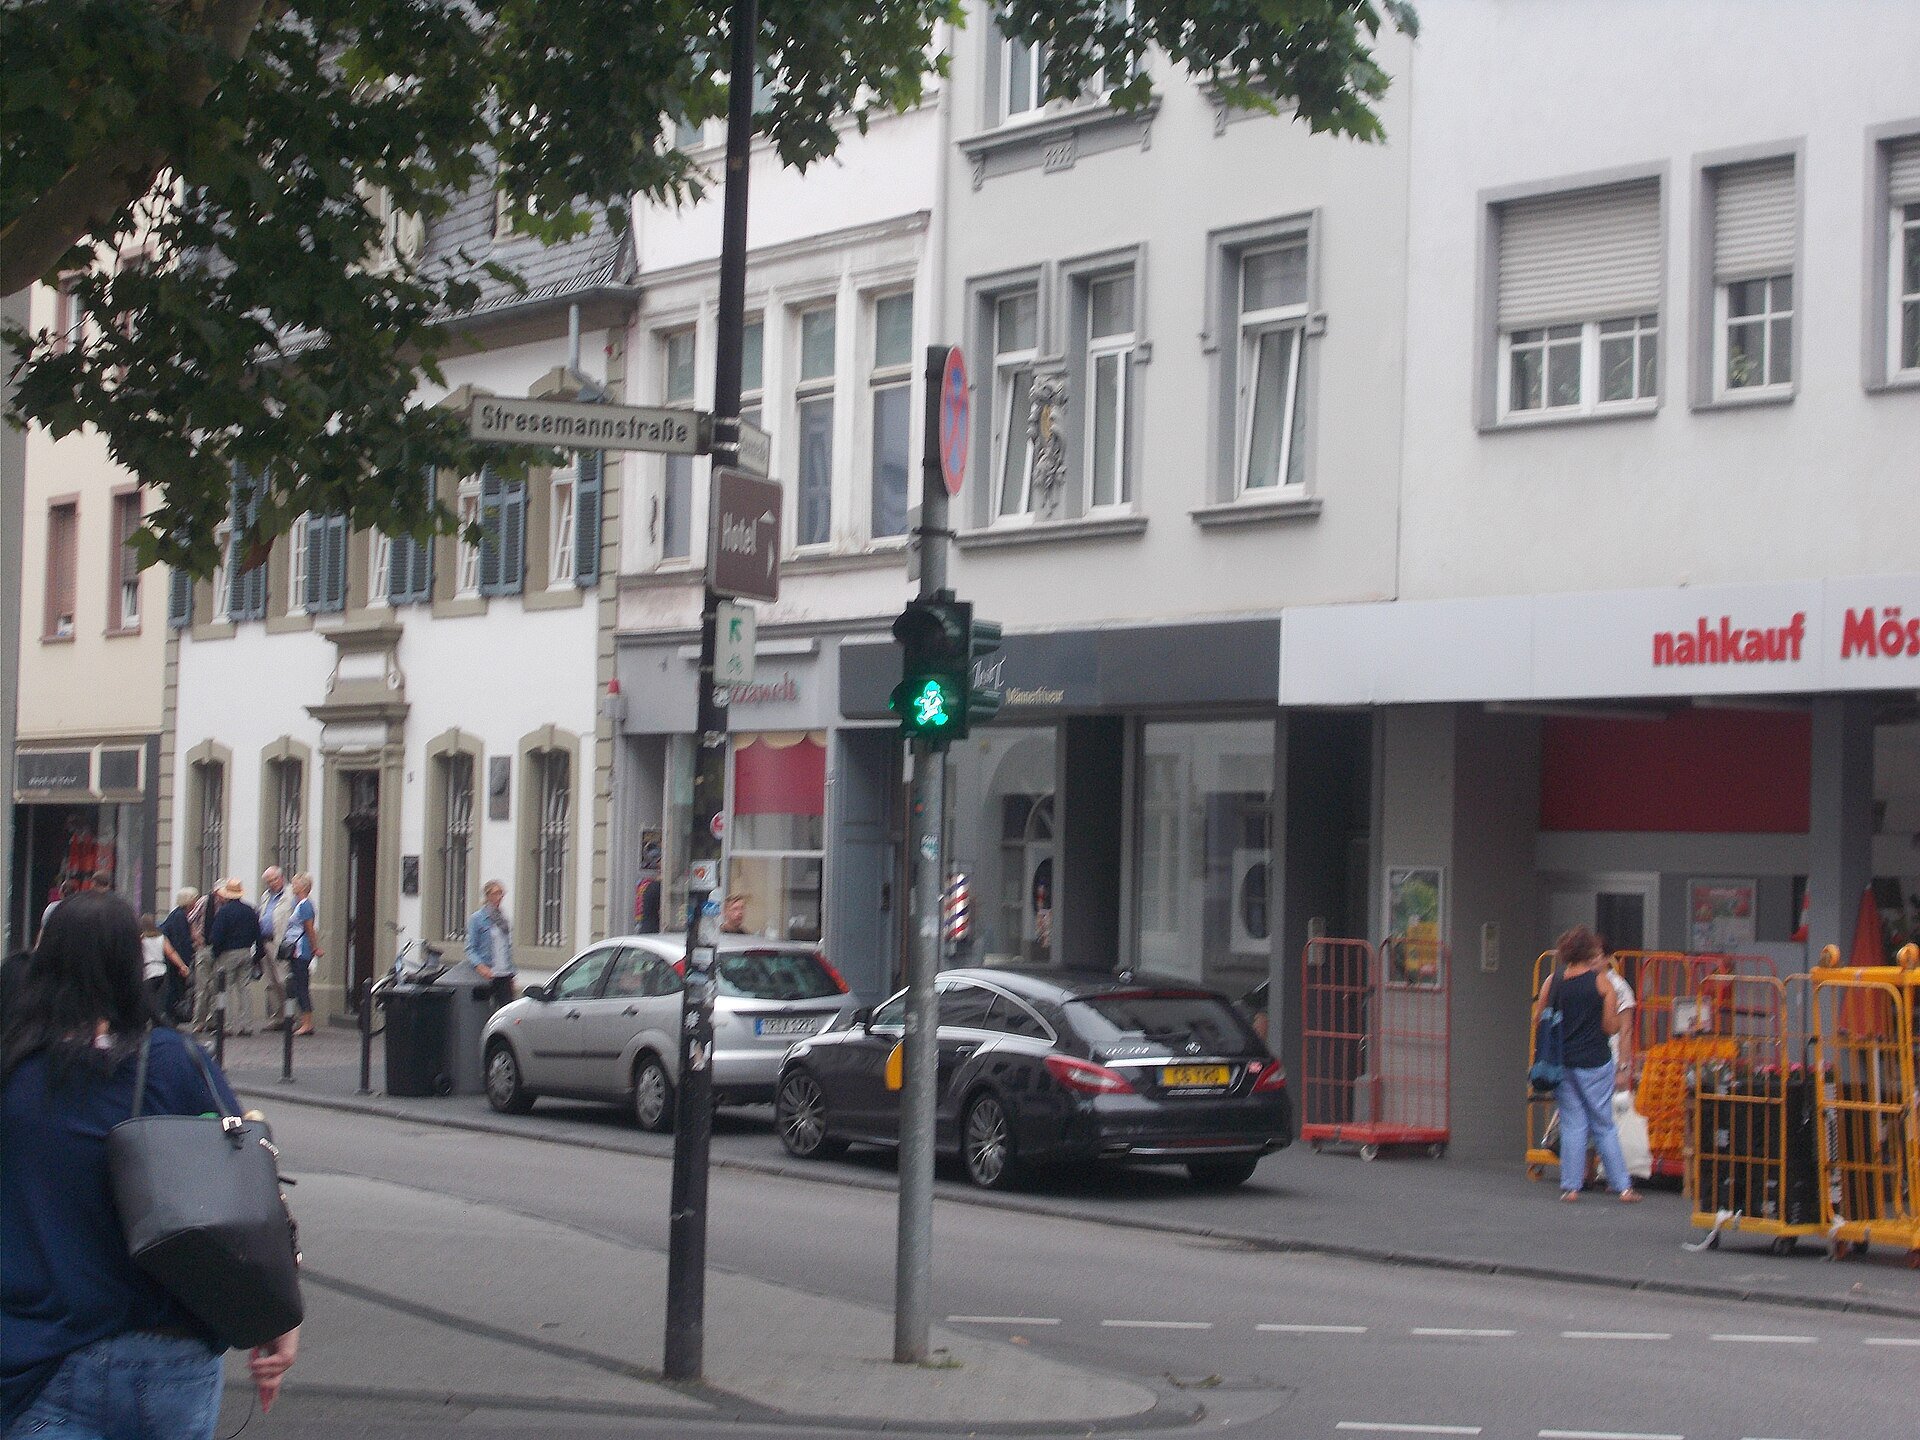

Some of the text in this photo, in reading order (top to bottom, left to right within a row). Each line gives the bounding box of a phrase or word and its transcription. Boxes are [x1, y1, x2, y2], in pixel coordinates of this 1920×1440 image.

[481, 403, 689, 444] Stresemannstraße
[722, 511, 758, 556] Hotel
[1653, 611, 1805, 667] nahkauf
